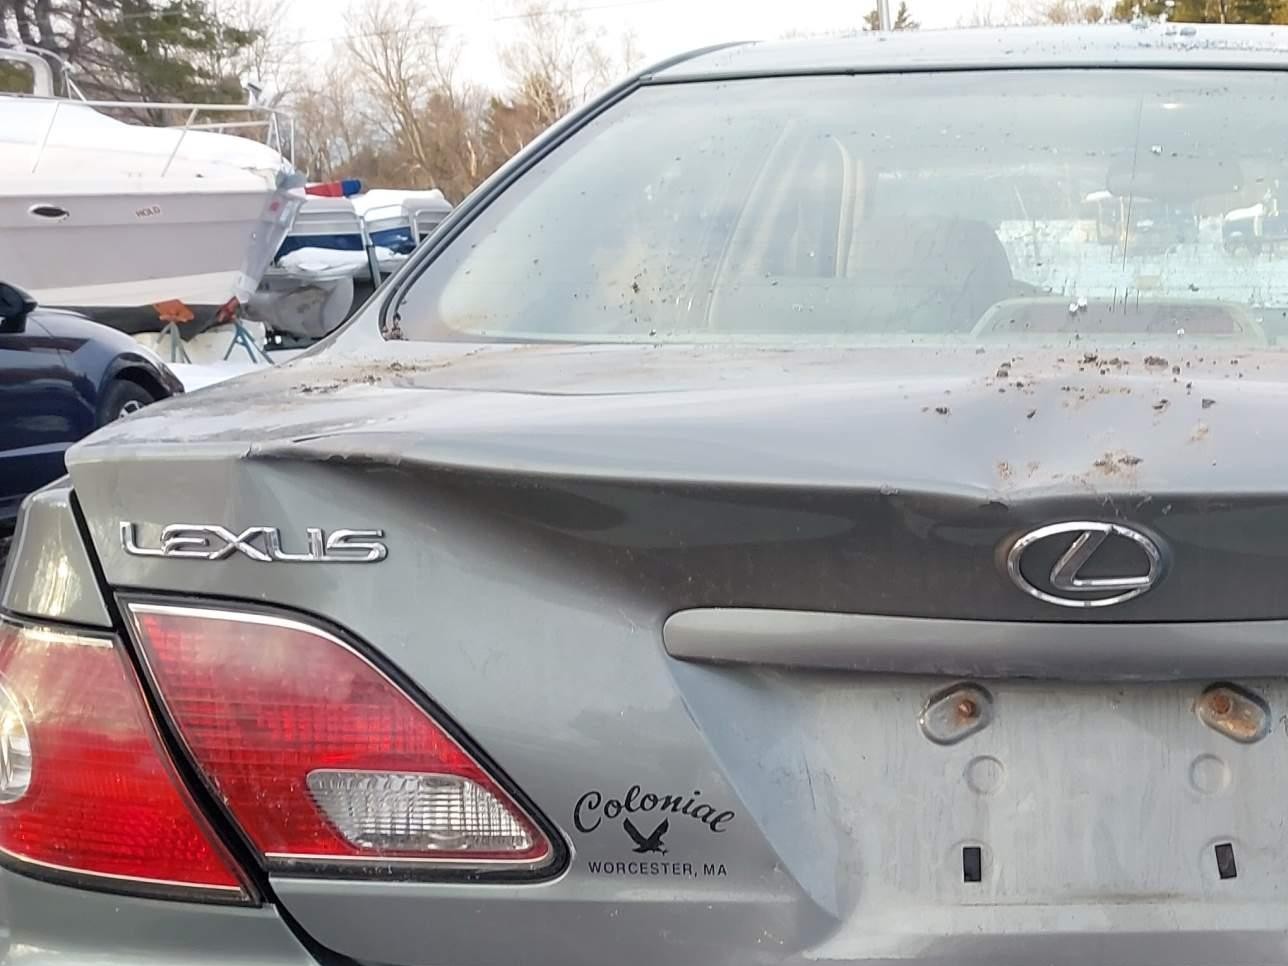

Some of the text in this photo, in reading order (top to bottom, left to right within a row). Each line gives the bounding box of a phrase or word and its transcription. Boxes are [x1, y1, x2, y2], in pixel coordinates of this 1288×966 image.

[119, 521, 388, 562] LEXUS
[573, 785, 735, 833] Colonial
[588, 861, 728, 878] WORCESTER, MA
